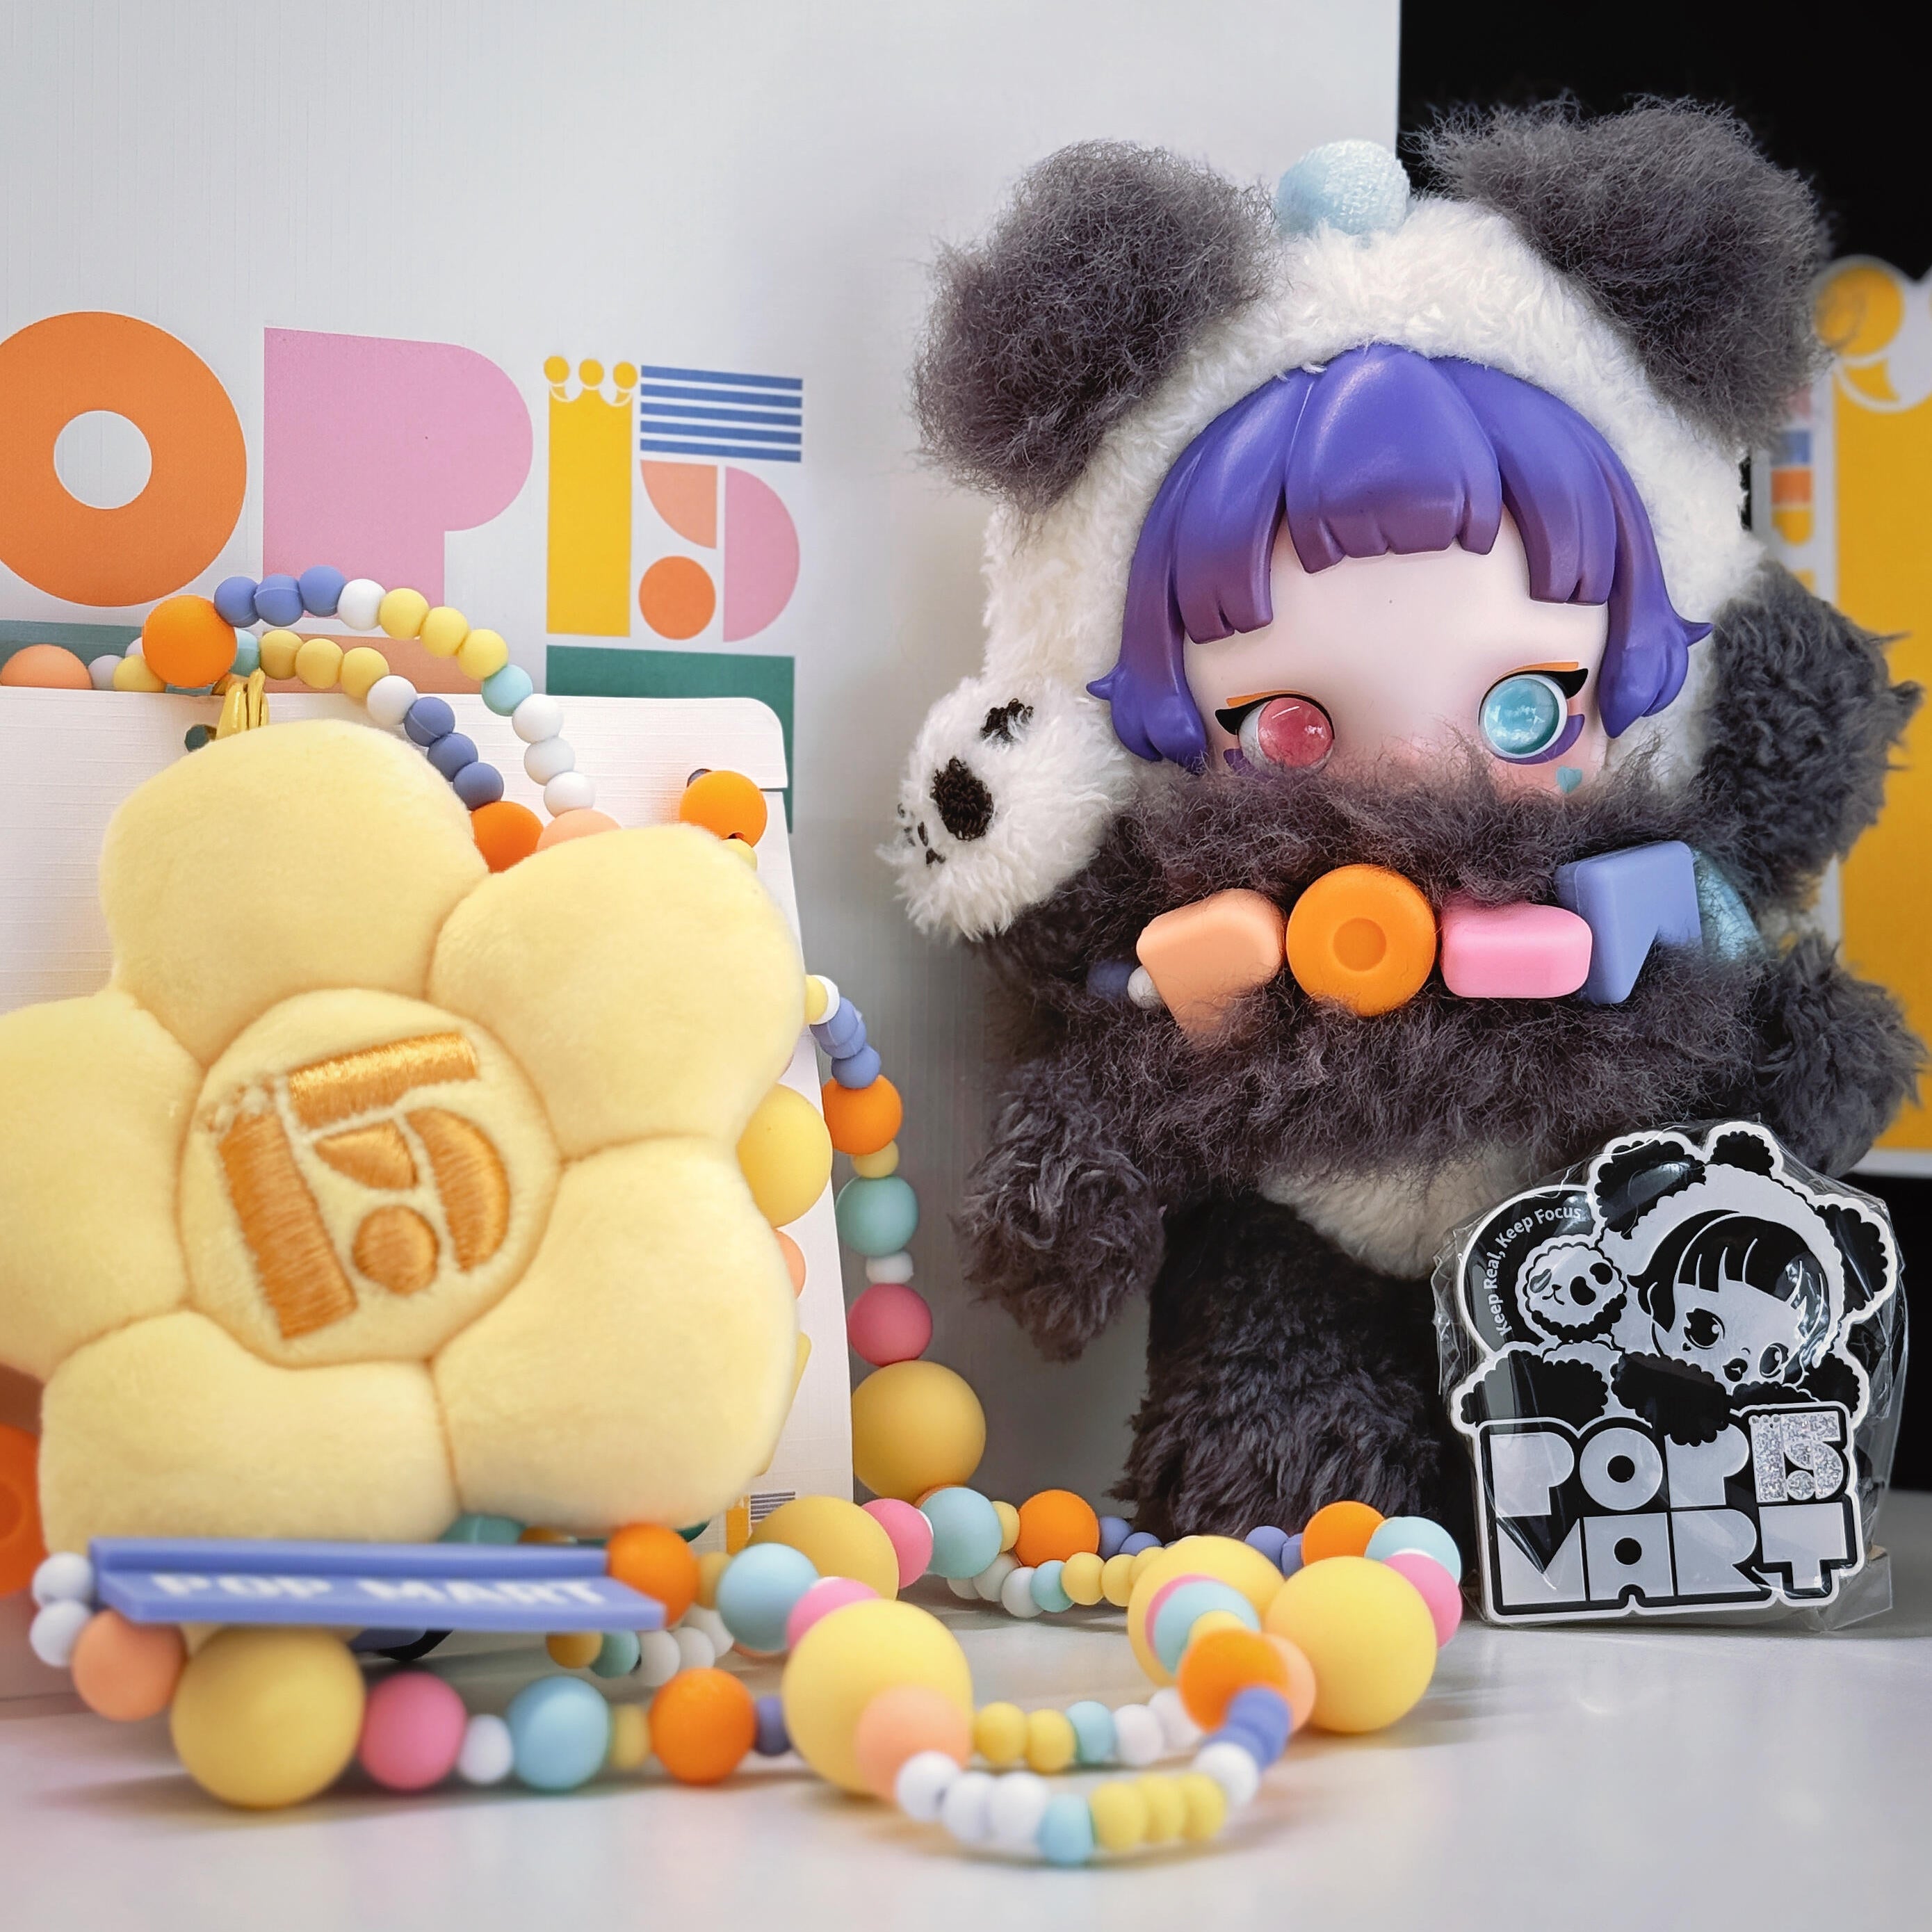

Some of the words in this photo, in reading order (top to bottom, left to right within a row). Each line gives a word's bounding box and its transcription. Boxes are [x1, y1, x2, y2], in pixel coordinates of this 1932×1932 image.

[1495, 1218, 1534, 1249] Keep
[1534, 1207, 1582, 1225] Focus
[1483, 1251, 1506, 1290] Real,
[1487, 1293, 1512, 1336] Keep
[1489, 1425, 1749, 1518] POP
[1495, 1502, 1848, 1607] MART
[152, 1574, 333, 1598] POP
[355, 1579, 608, 1606] MART
